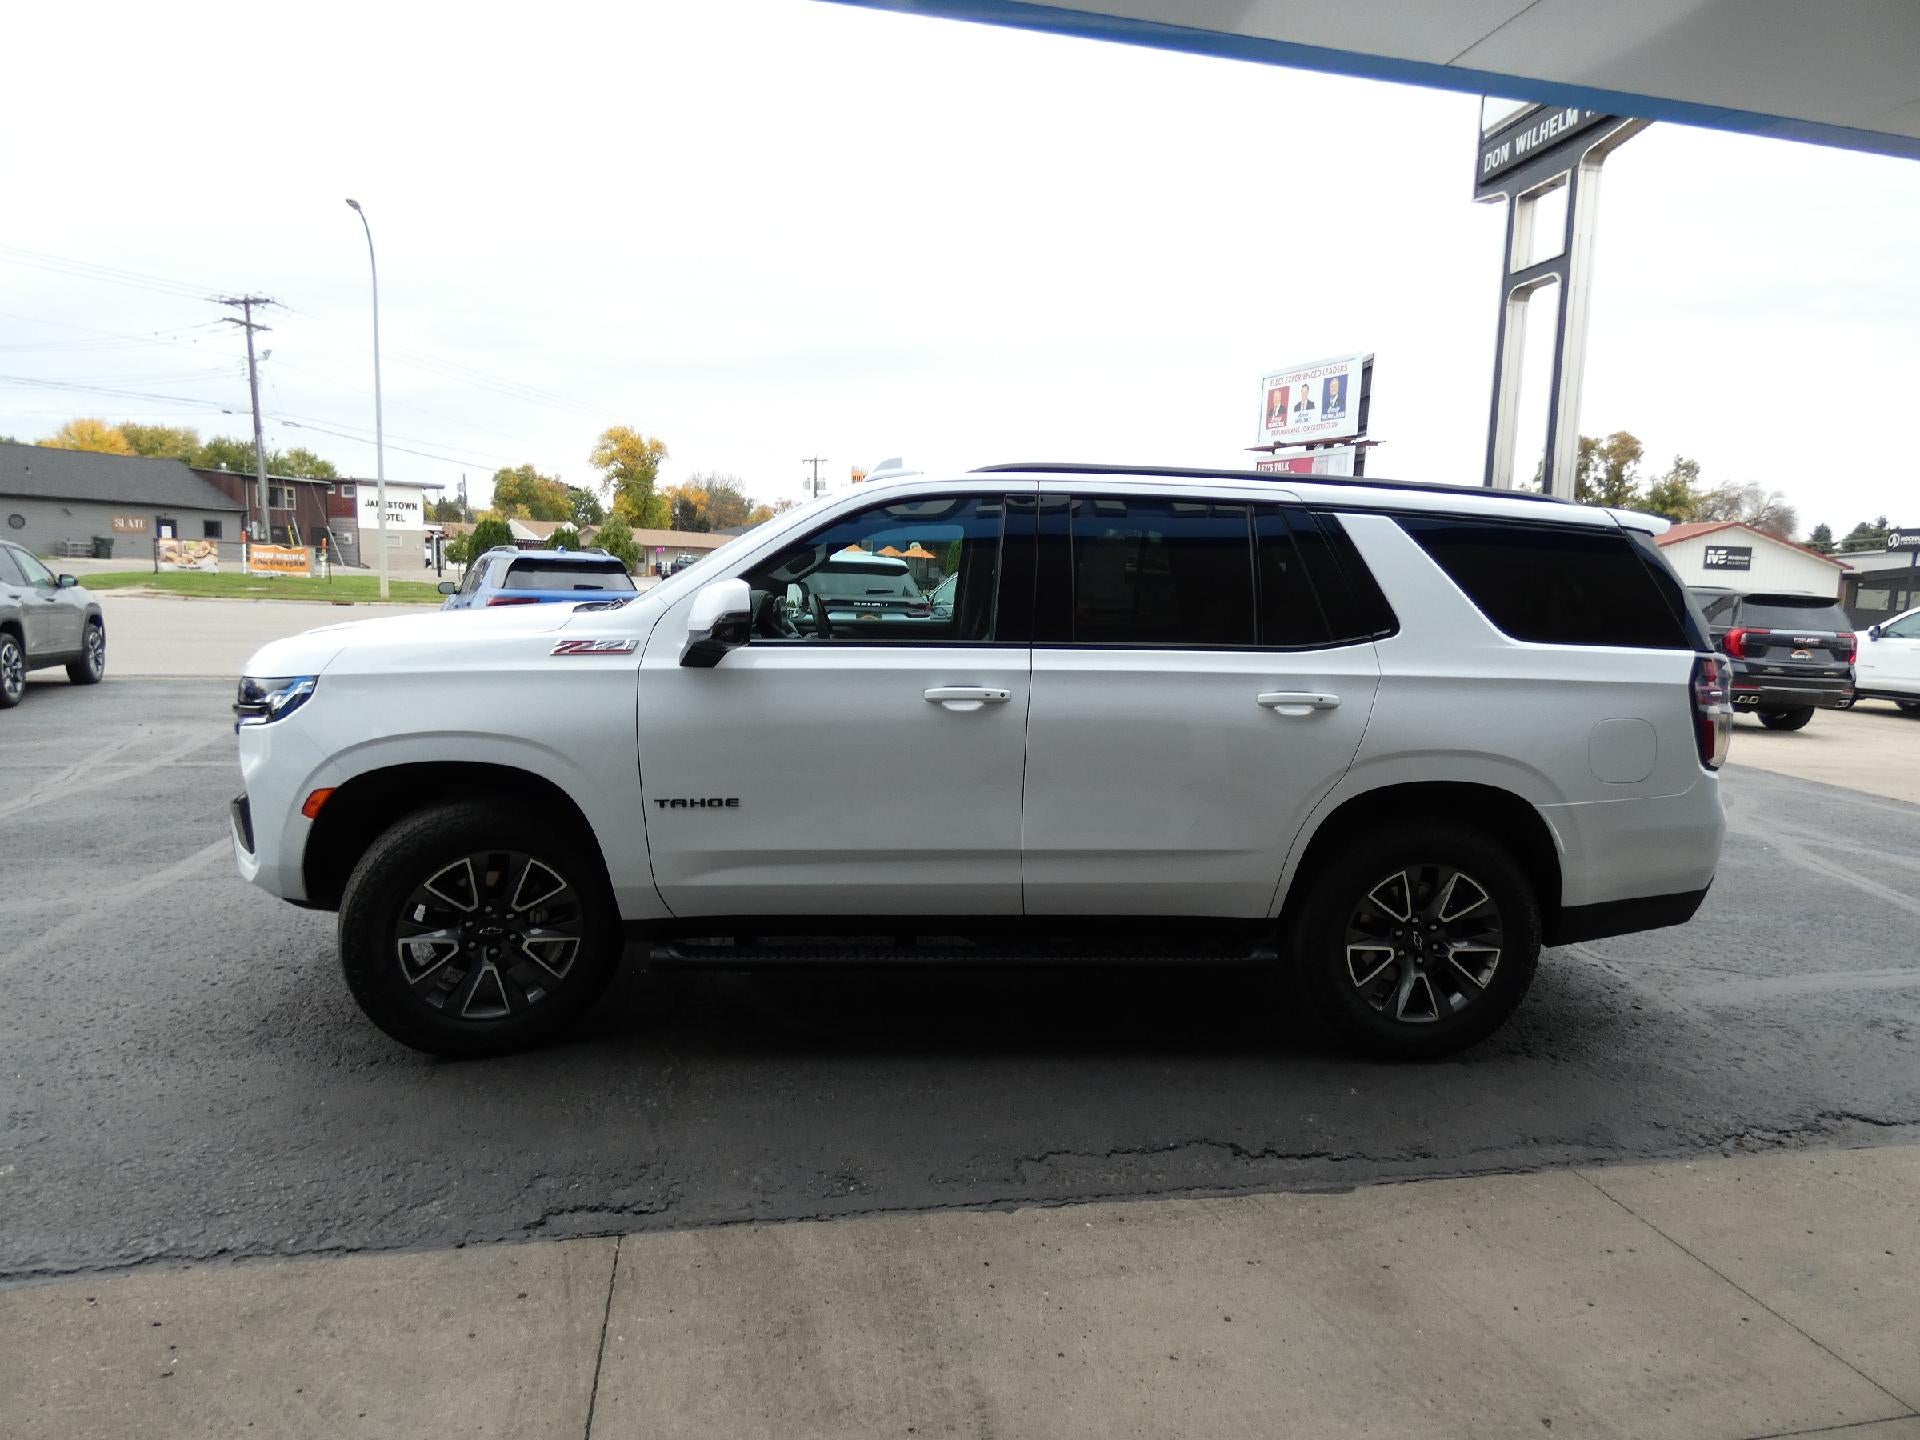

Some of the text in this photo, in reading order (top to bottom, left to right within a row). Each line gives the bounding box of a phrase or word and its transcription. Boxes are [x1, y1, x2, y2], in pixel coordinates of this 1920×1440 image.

[1484, 108, 1578, 173] DON WILHELM
[1322, 365, 1347, 376] LEADERS
[1273, 461, 1290, 471] TALK
[365, 499, 418, 511] JASTOWN
[377, 513, 406, 523] OTEL
[550, 639, 640, 656] Z71
[653, 797, 740, 809] TAHOE
